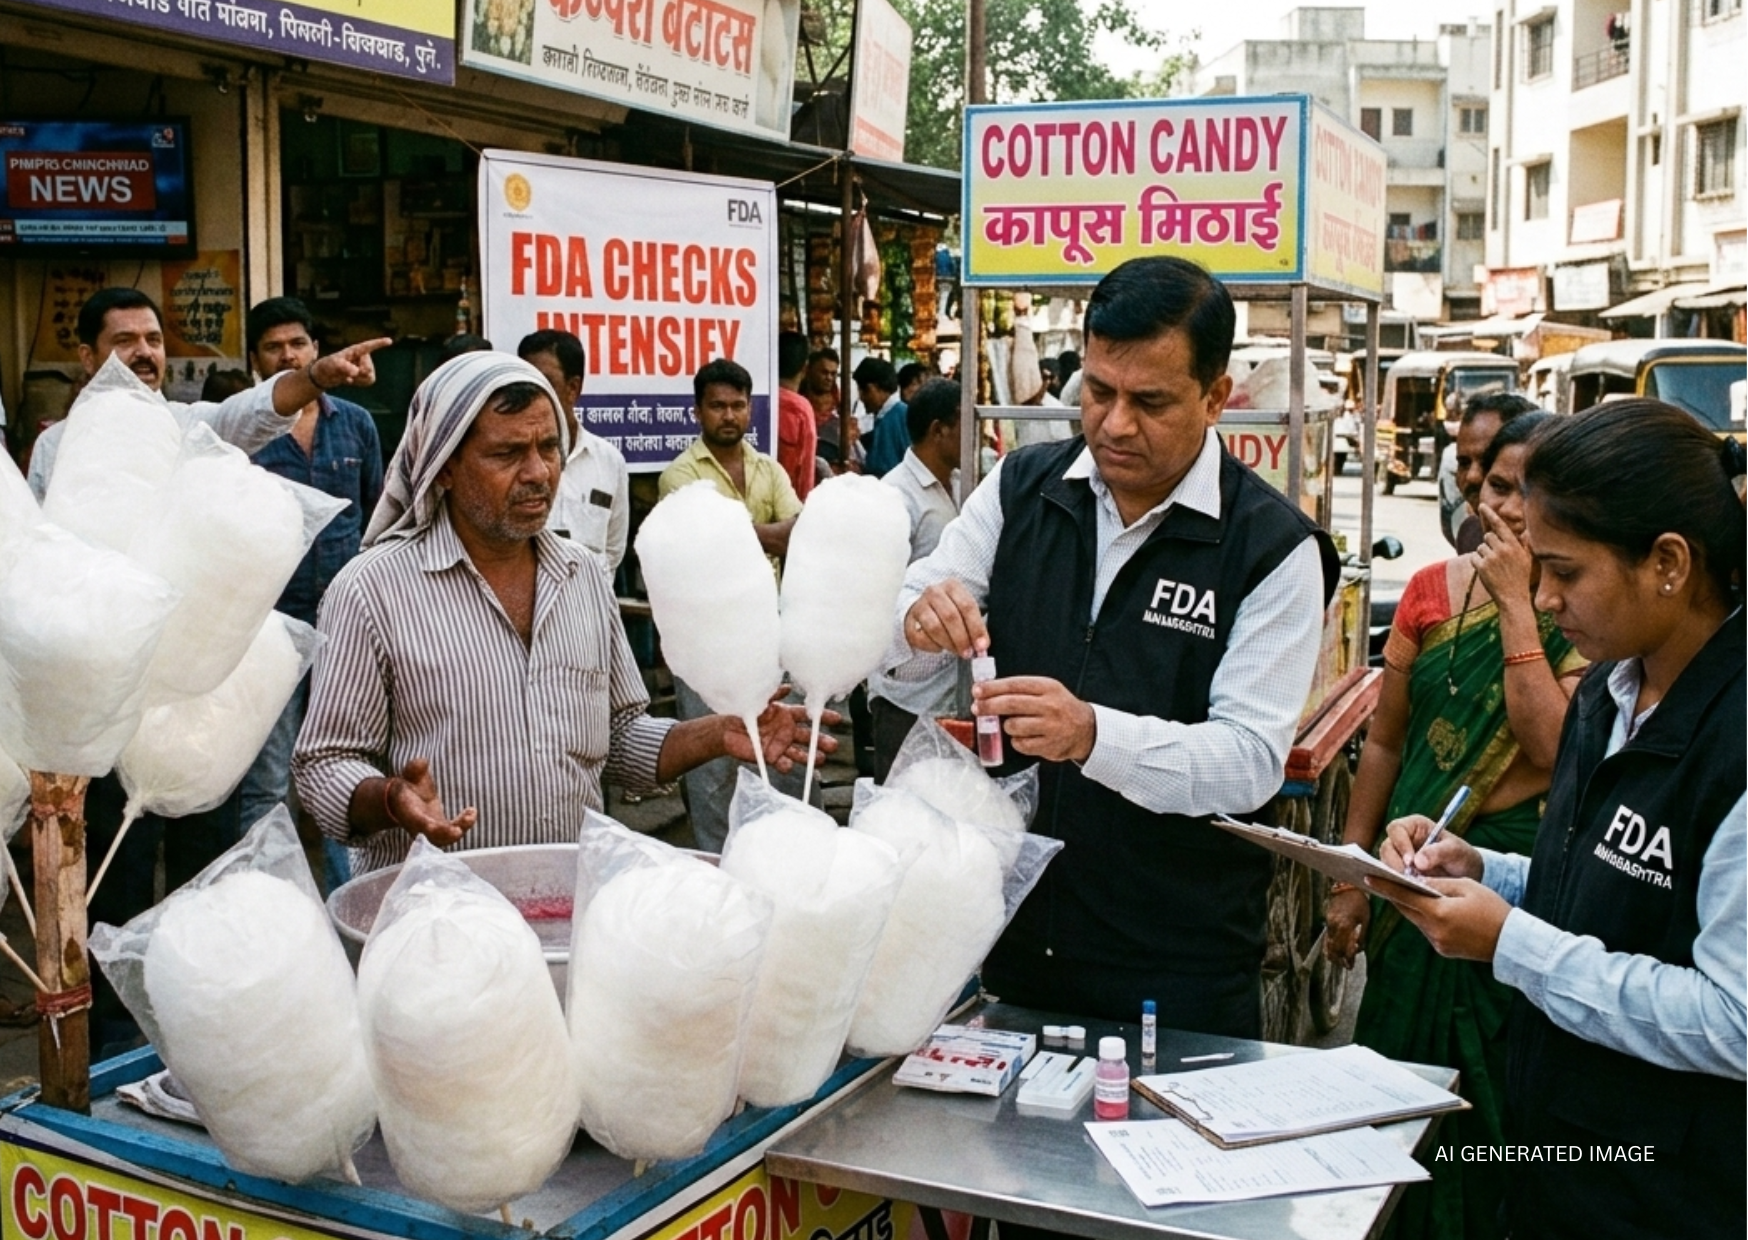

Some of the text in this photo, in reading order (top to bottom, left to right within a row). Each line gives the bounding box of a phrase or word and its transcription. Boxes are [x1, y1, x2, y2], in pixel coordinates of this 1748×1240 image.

[982, 115, 1288, 179] COTTON CANDY
[30, 175, 133, 203] NEWS
[728, 199, 763, 224] FDA
[983, 204, 1126, 265] कापूस
[1137, 182, 1283, 251] मिठाई
[511, 231, 757, 307] FDA CHECKS
[1150, 578, 1216, 624] FDA
[1604, 804, 1673, 870] FDA
